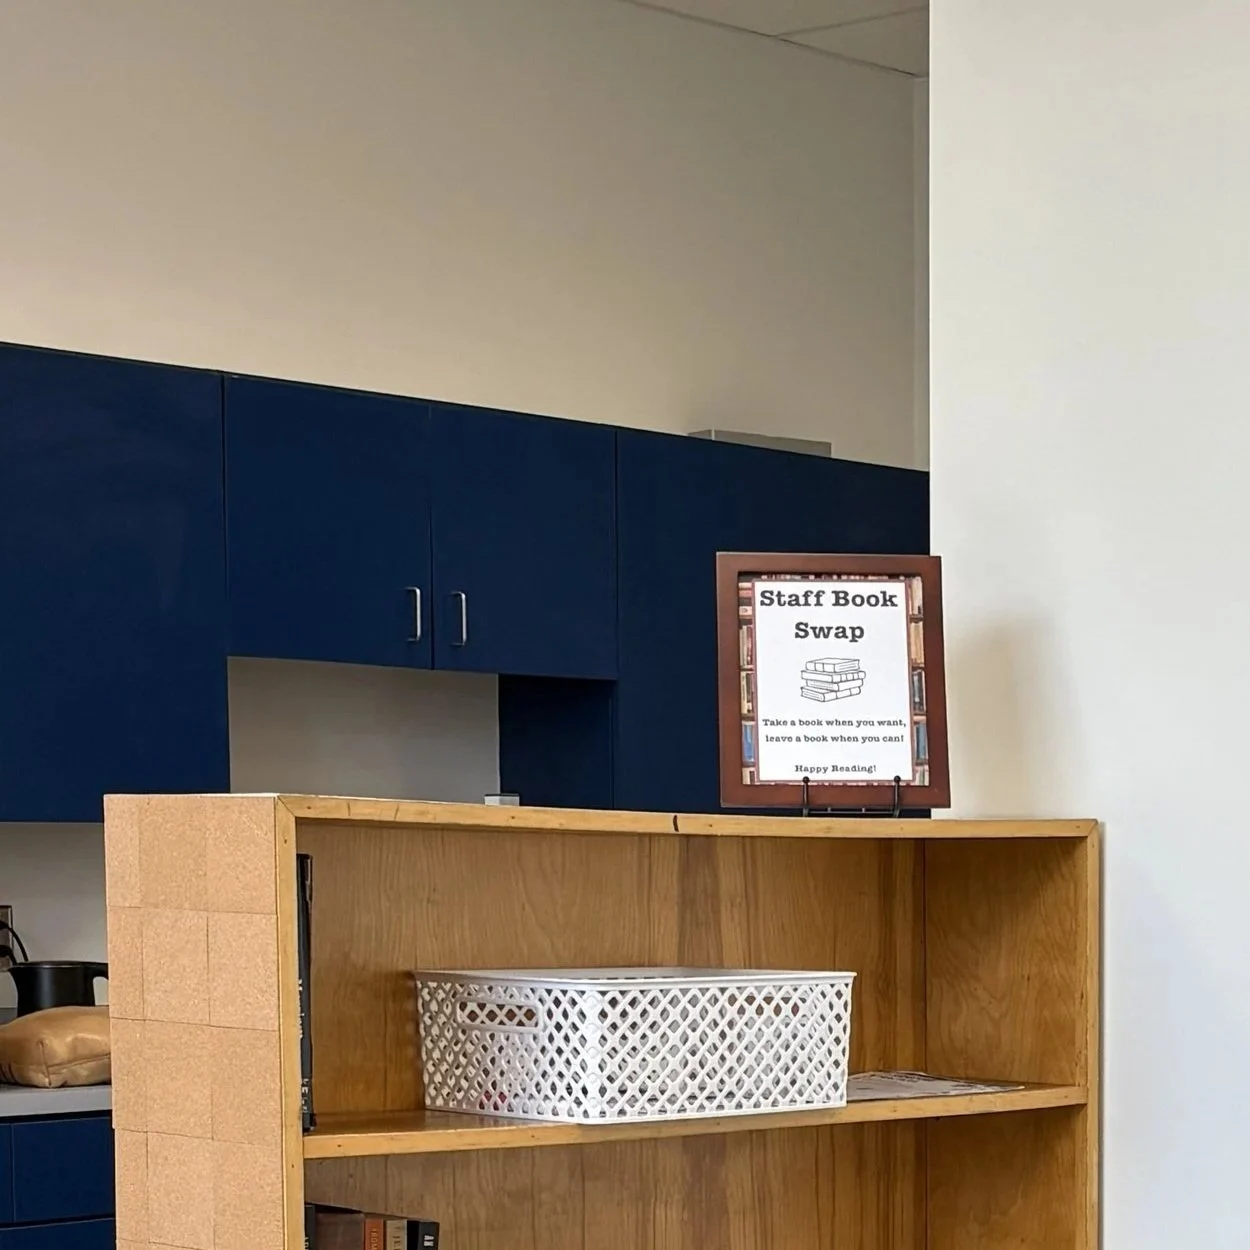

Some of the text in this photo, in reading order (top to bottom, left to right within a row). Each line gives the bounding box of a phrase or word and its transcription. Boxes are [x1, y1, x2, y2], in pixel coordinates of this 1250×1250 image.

[760, 589, 898, 608] Staff Book
[794, 621, 865, 643] Swap
[762, 718, 788, 727] Take
[799, 718, 823, 727] book
[825, 718, 854, 727] when
[855, 720, 875, 728] you
[876, 719, 907, 728] want,
[765, 734, 793, 743] leave
[803, 734, 829, 743] book
[830, 734, 859, 743] when
[860, 736, 880, 745] you
[882, 734, 905, 743] can!
[794, 764, 877, 774] Happy Reading!
[423, 1234, 434, 1247] AN
